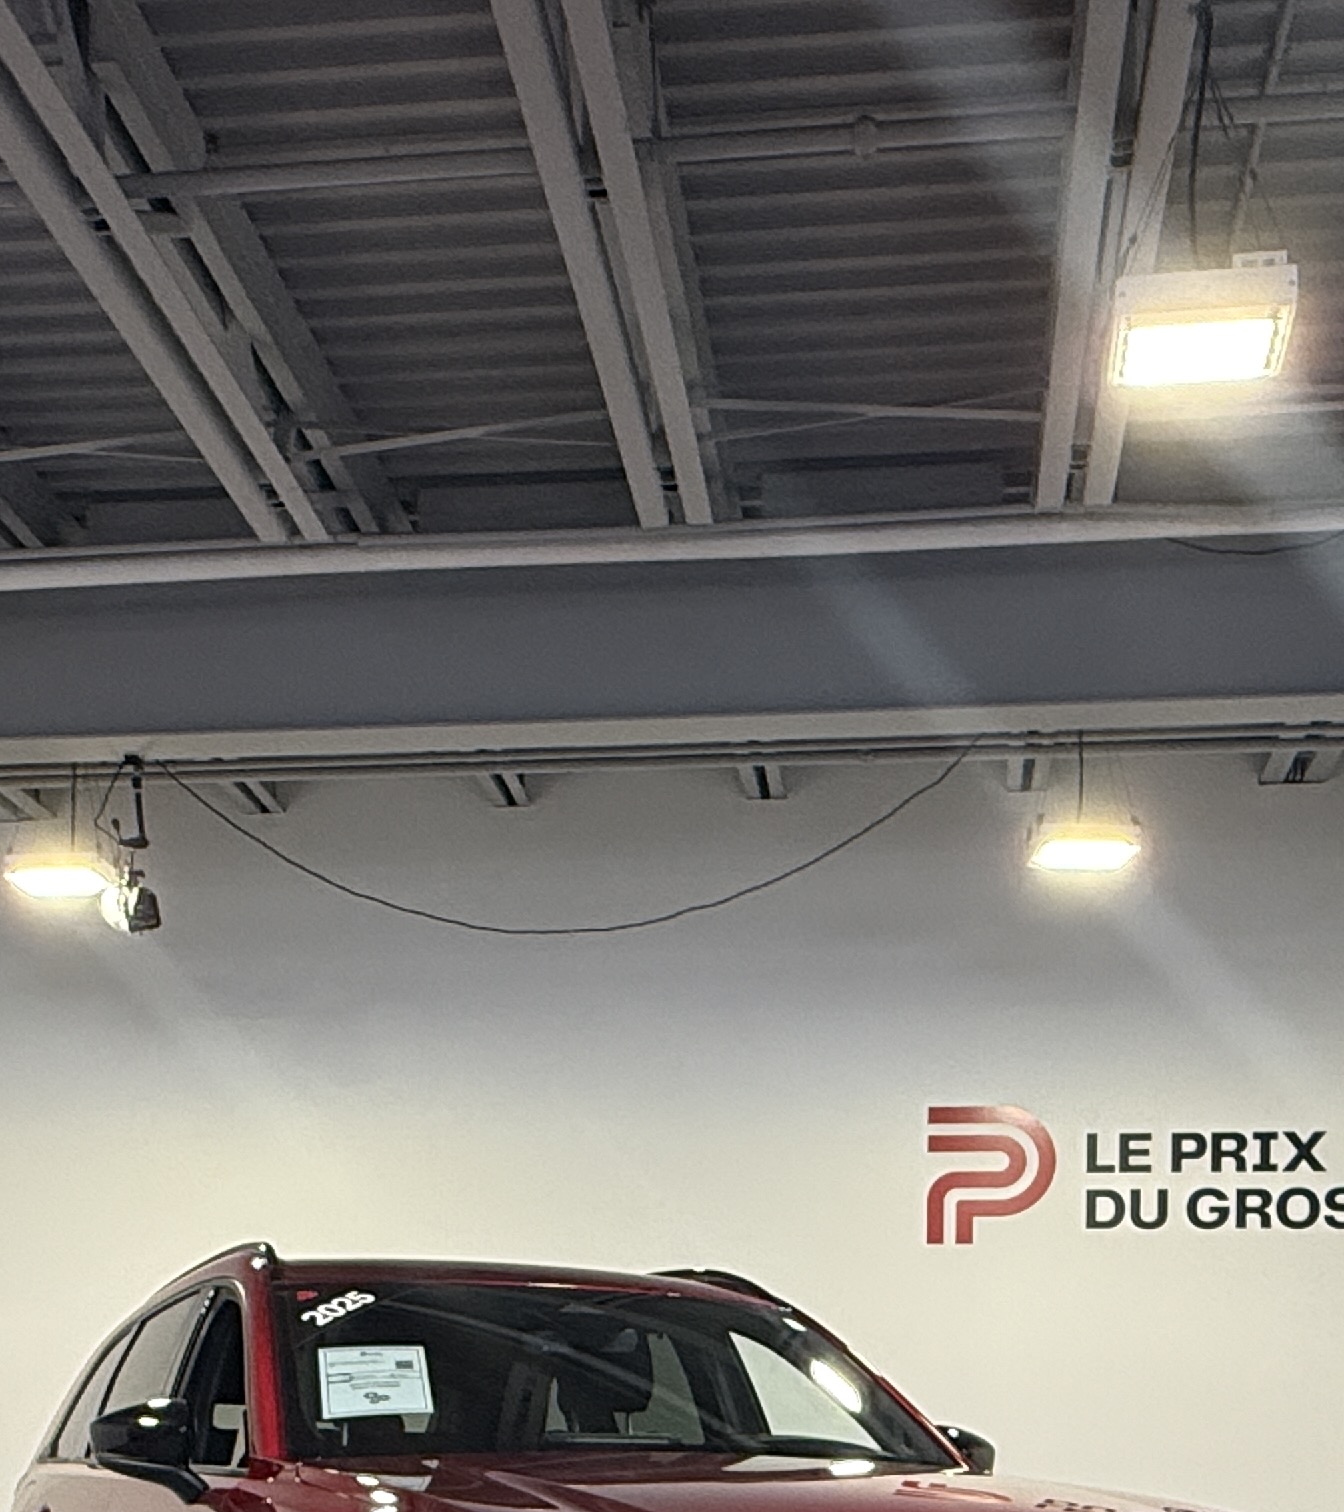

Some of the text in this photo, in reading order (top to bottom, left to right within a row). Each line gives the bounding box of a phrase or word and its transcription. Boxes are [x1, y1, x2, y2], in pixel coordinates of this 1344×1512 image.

[1086, 1131, 1327, 1173] LE PRIX
[1085, 1188, 1169, 1230] DU
[300, 1290, 376, 1327] 2025
